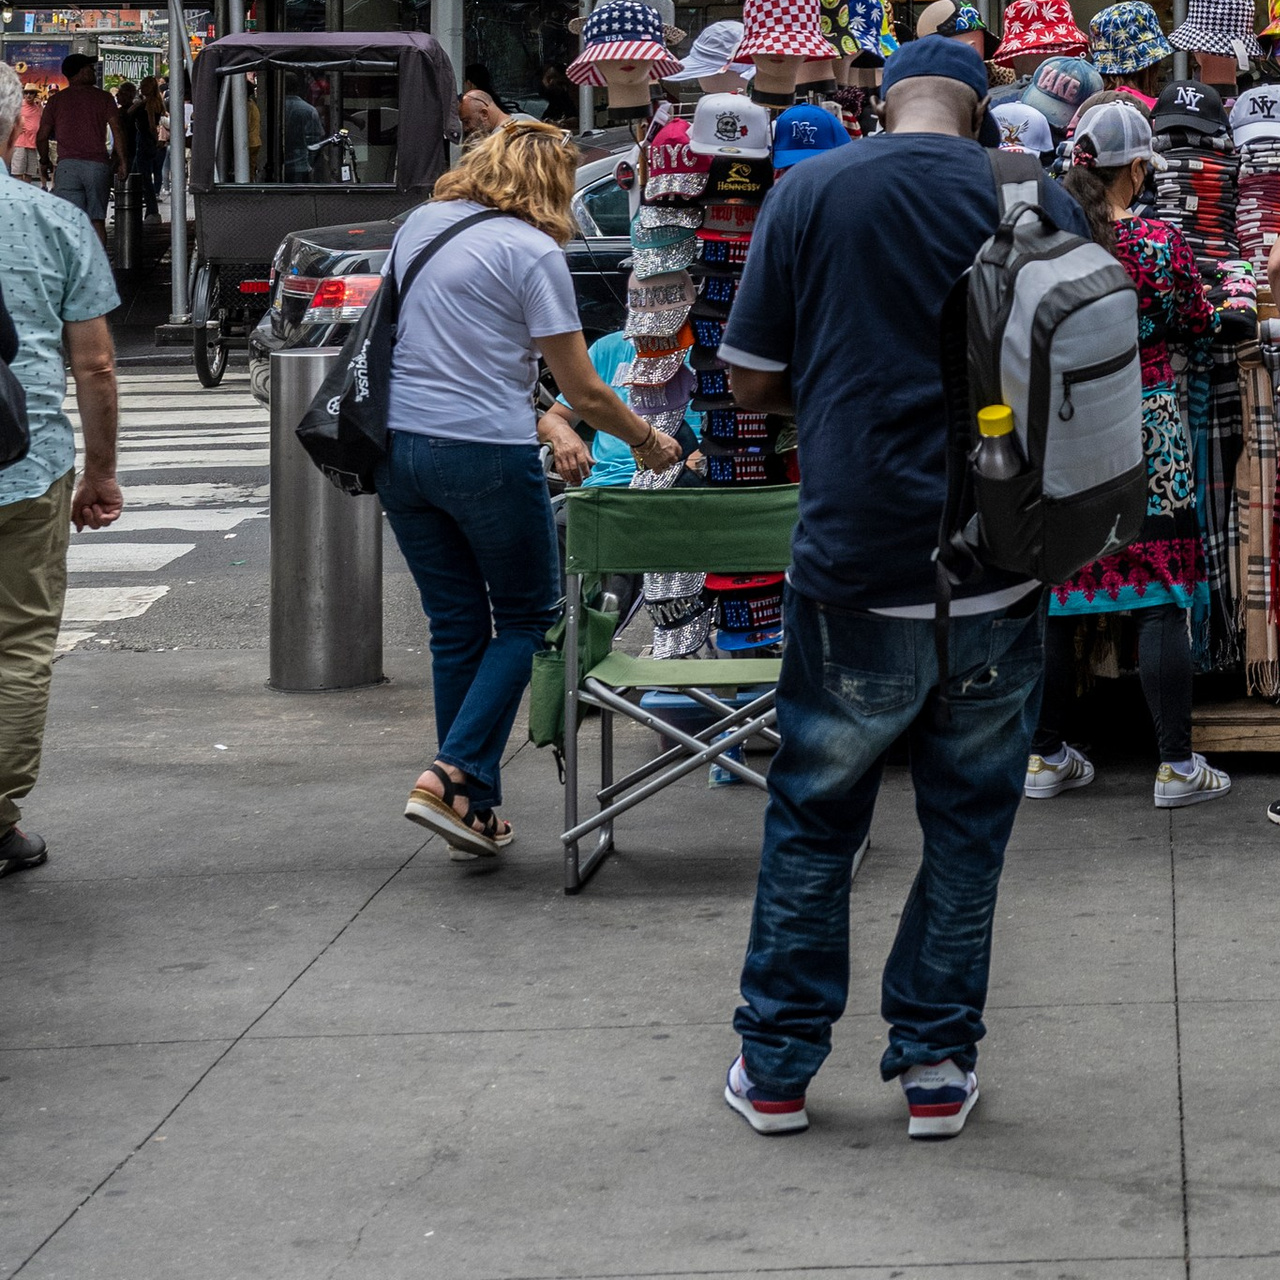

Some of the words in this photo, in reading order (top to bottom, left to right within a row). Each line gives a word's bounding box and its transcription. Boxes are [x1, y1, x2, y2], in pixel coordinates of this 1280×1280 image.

[605, 34, 624, 42] USA
[104, 53, 149, 62] DISCOVER
[1174, 86, 1204, 112] NY
[1249, 95, 1278, 119] NY
[791, 120, 818, 145] NY
[651, 143, 698, 171] NYC
